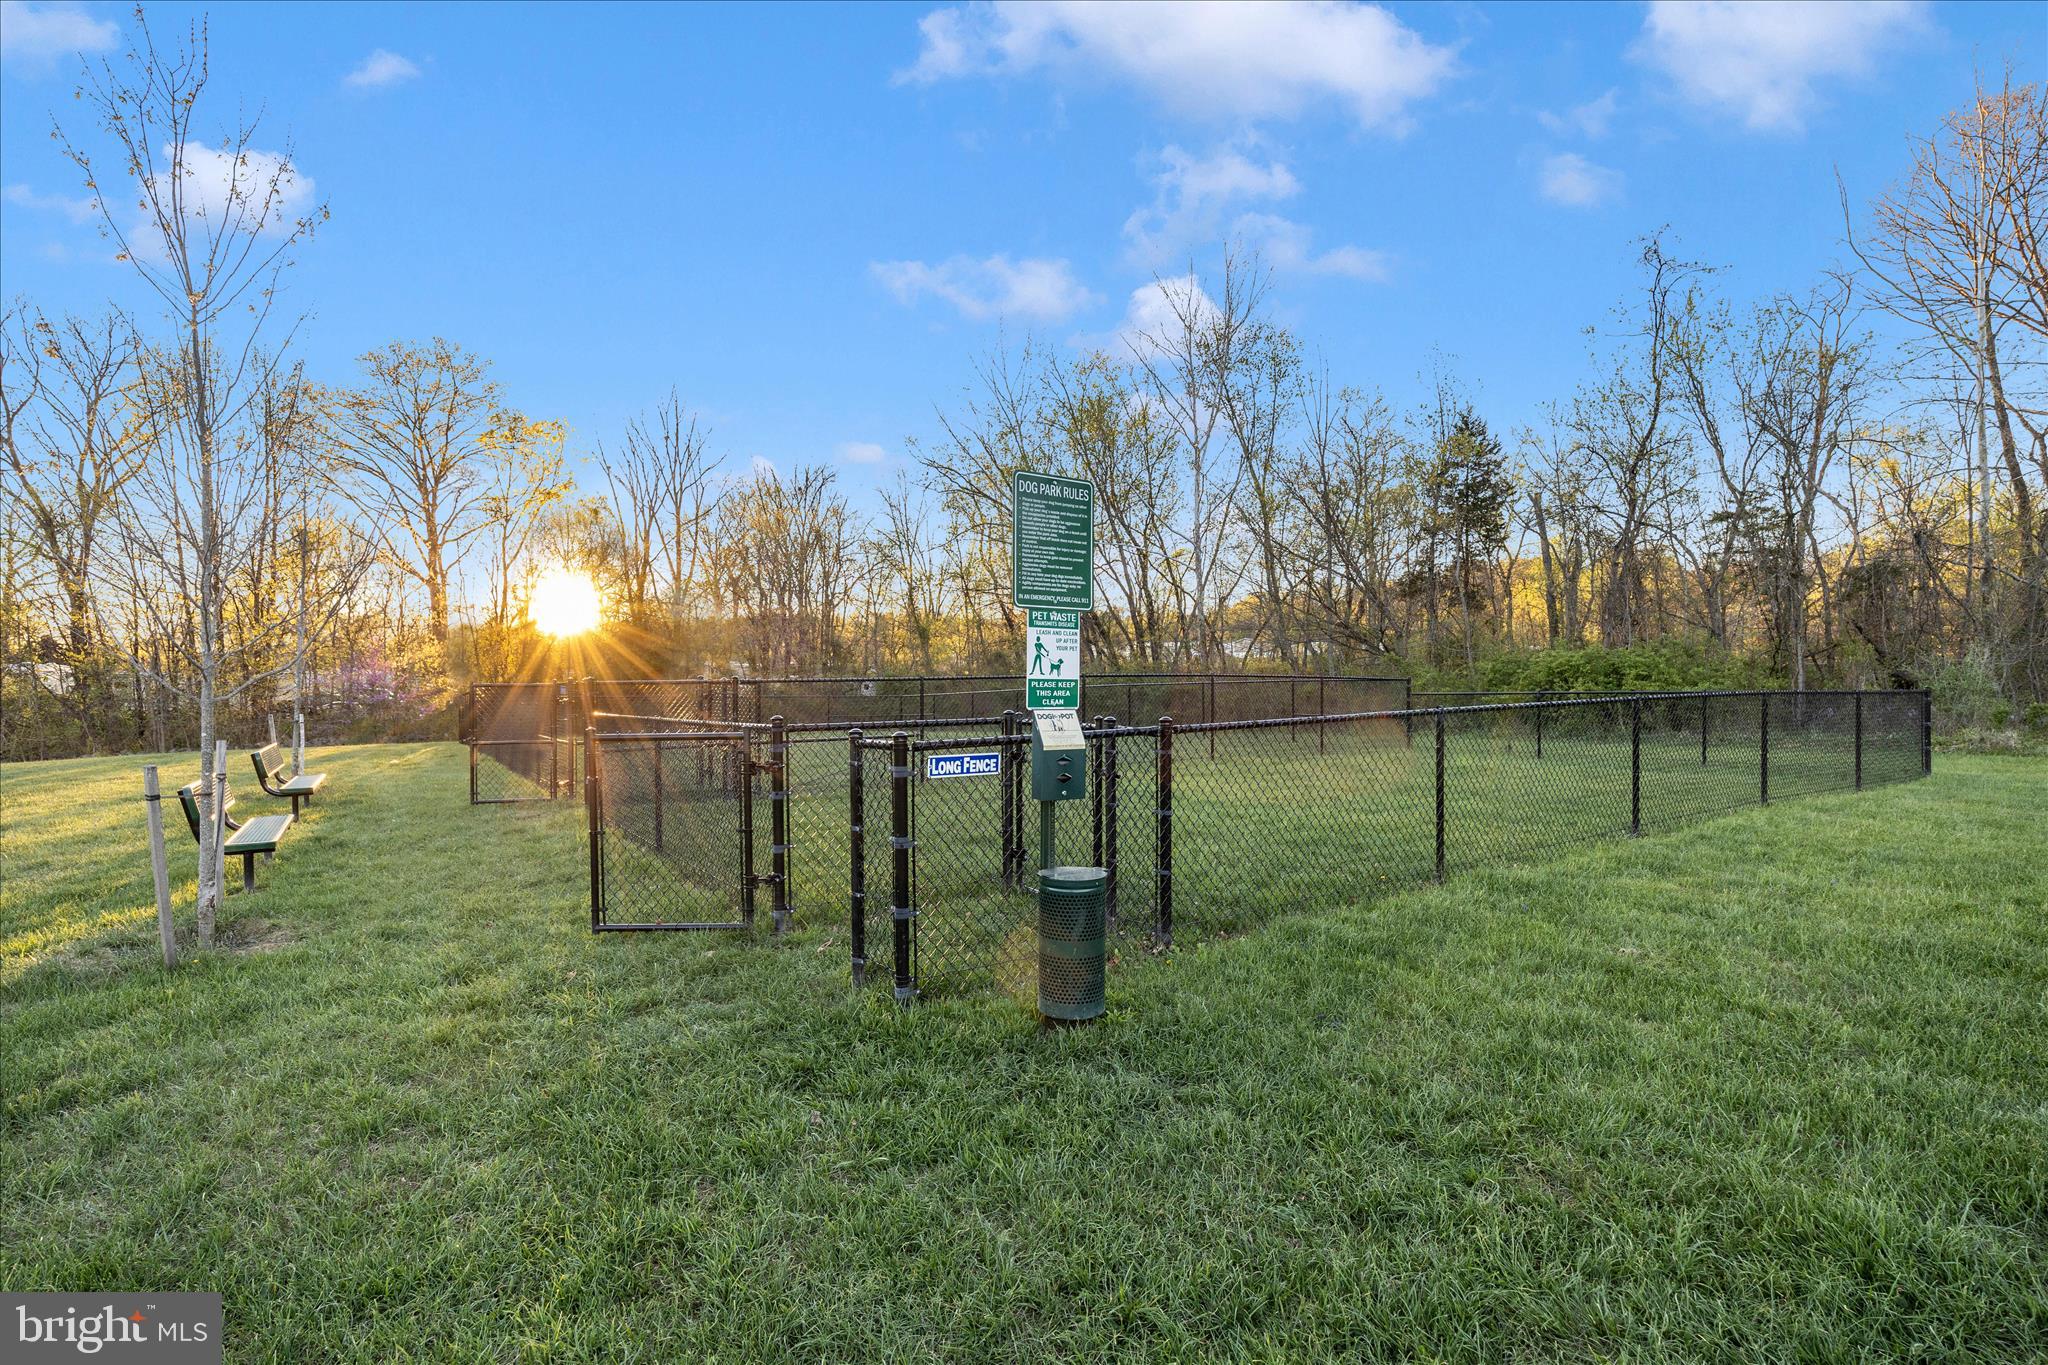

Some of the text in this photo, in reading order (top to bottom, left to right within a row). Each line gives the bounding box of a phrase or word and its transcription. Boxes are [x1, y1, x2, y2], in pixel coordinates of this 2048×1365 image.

[1019, 480, 1038, 493] DOG
[1040, 483, 1062, 497] PARK
[1064, 487, 1089, 501] RULES
[1032, 612, 1076, 622] PET WASTE
[932, 757, 997, 774] LONG FENCE
